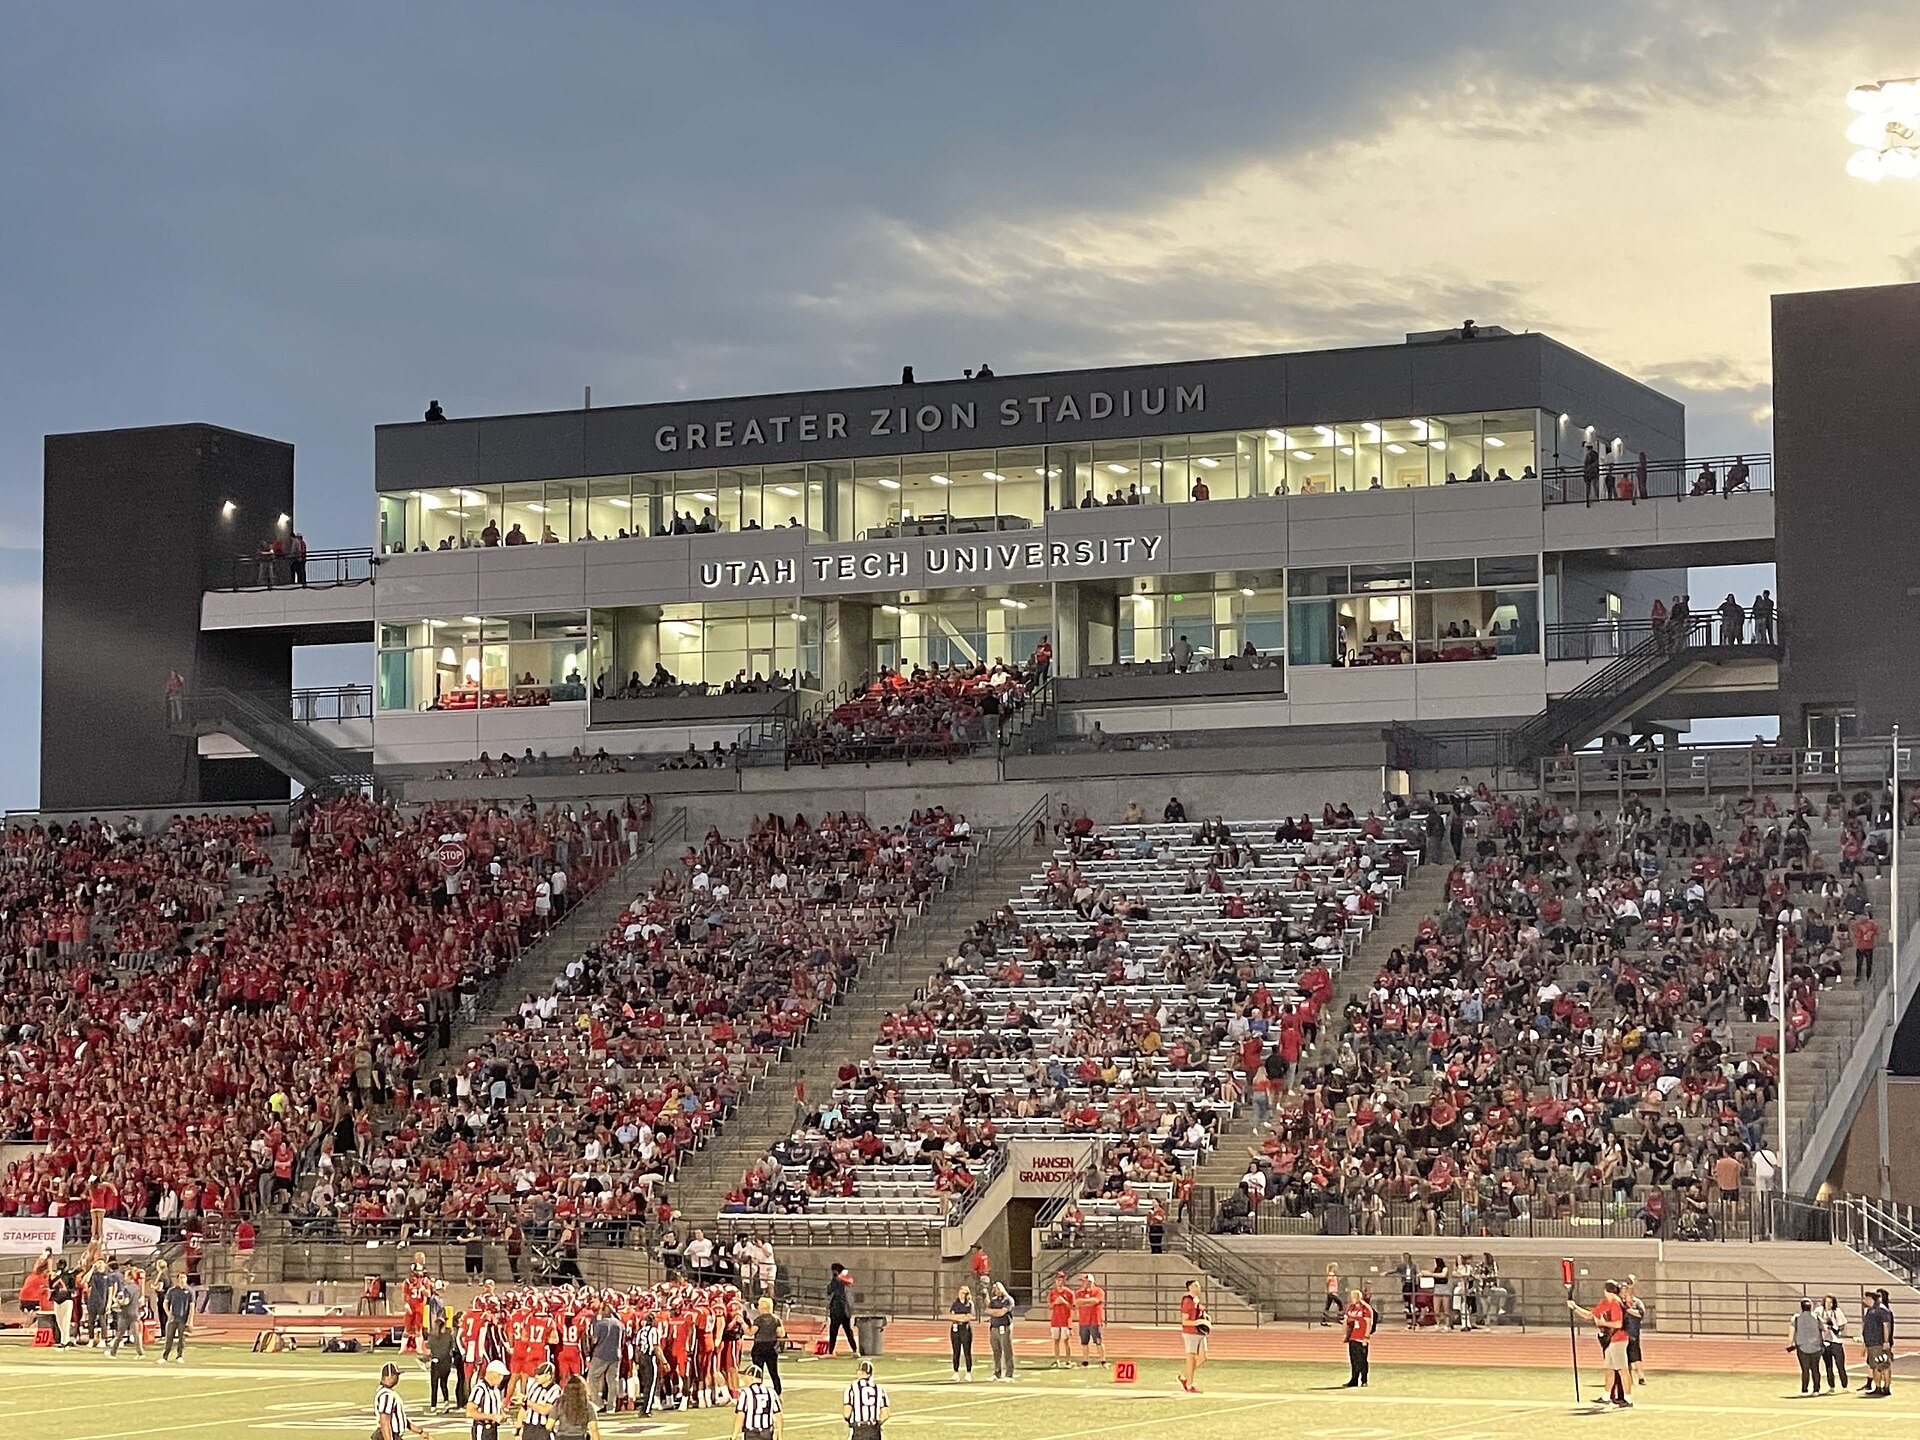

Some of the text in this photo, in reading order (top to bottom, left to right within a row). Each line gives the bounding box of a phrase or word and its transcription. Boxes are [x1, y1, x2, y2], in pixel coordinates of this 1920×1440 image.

[655, 384, 1206, 452] GREATER ZION STADIUM
[701, 535, 1162, 588] UTAH TECH UNIVERSITY
[440, 850, 462, 860] STOP
[1033, 1157, 1074, 1168] HANSEN
[3, 1231, 57, 1241] STAMPEDE
[467, 1318, 474, 1336] 7
[529, 1325, 545, 1343] 17
[562, 1324, 578, 1342] 18
[35, 1330, 50, 1344] 50
[640, 1330, 648, 1346] S
[1117, 1363, 1135, 1379] 20
[861, 1386, 876, 1406] C
